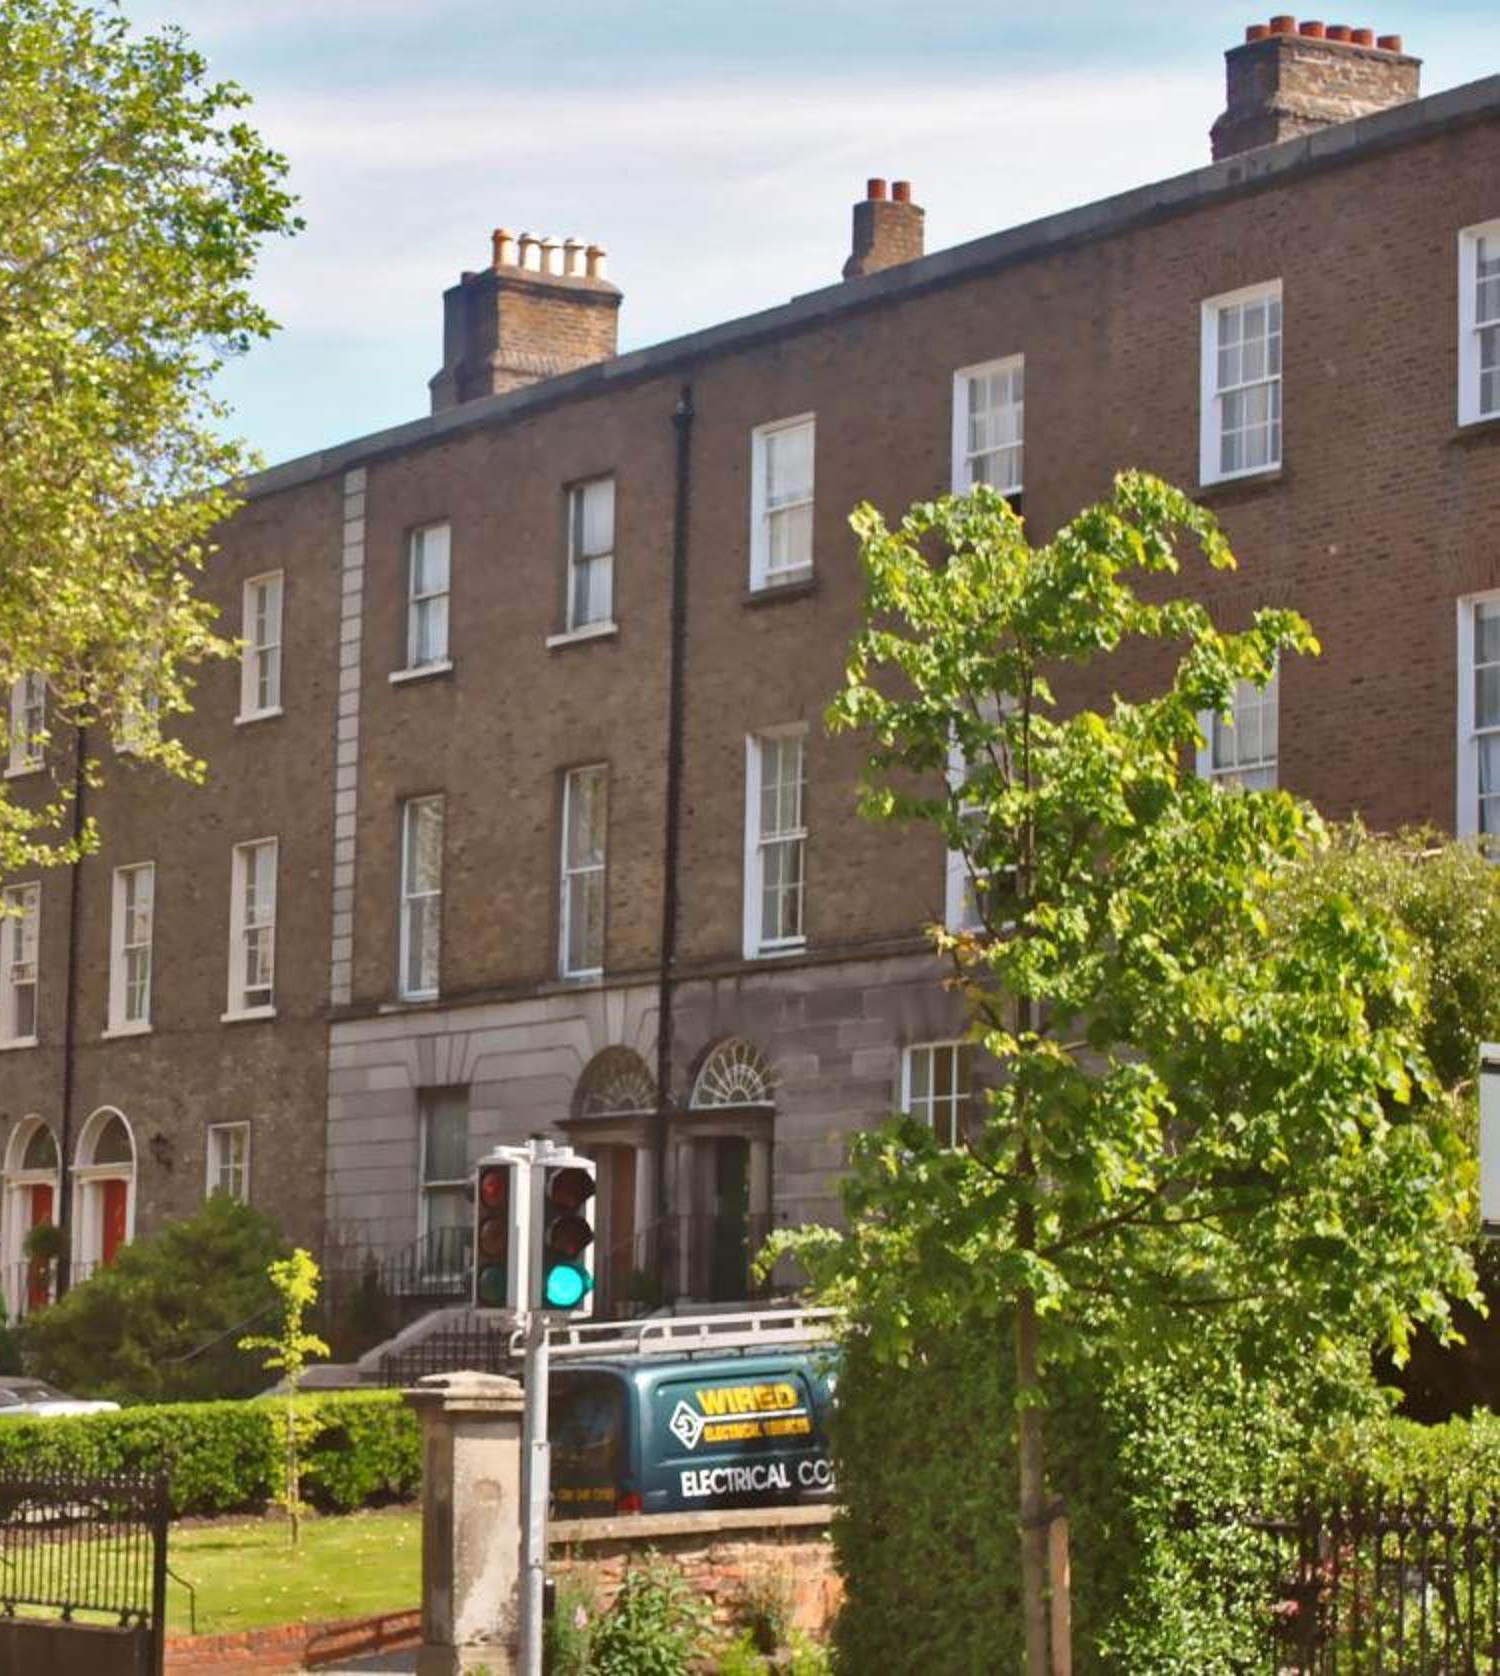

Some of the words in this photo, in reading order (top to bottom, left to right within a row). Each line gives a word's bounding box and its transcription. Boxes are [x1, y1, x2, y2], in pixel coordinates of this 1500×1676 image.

[697, 1382, 798, 1415] WIRED
[681, 1462, 791, 1497] ELECTRICAL
[798, 1459, 836, 1485] CO
